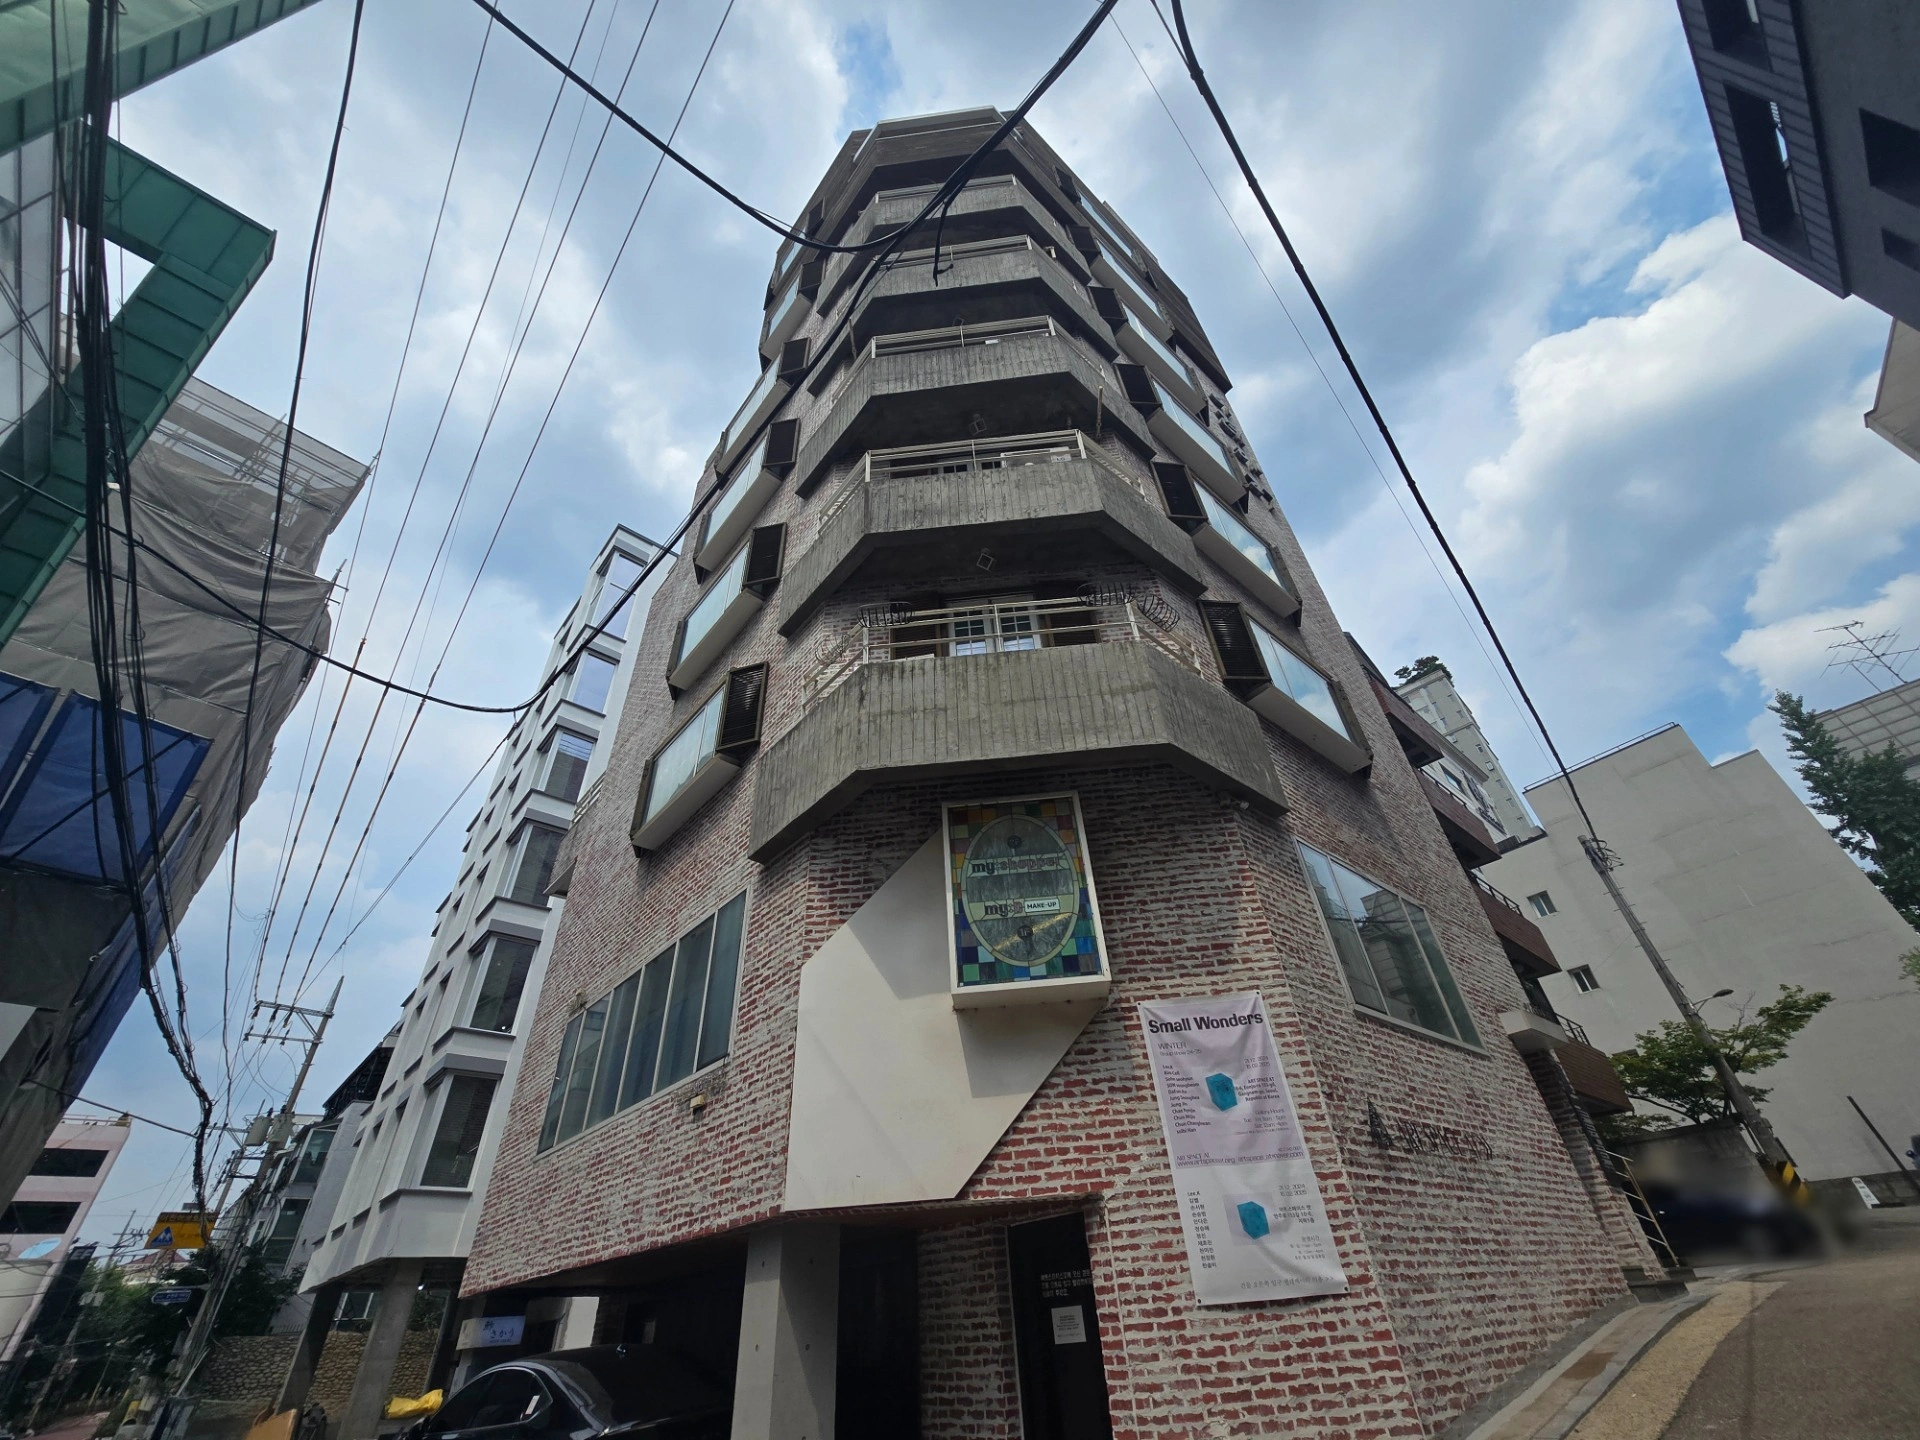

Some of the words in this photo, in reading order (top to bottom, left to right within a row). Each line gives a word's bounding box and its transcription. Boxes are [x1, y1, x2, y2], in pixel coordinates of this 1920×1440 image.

[1026, 901, 1057, 910] MAKE-UP
[1148, 1017, 1191, 1034] Small
[1193, 1013, 1263, 1030] Wonders
[1158, 1042, 1186, 1050] WINTER
